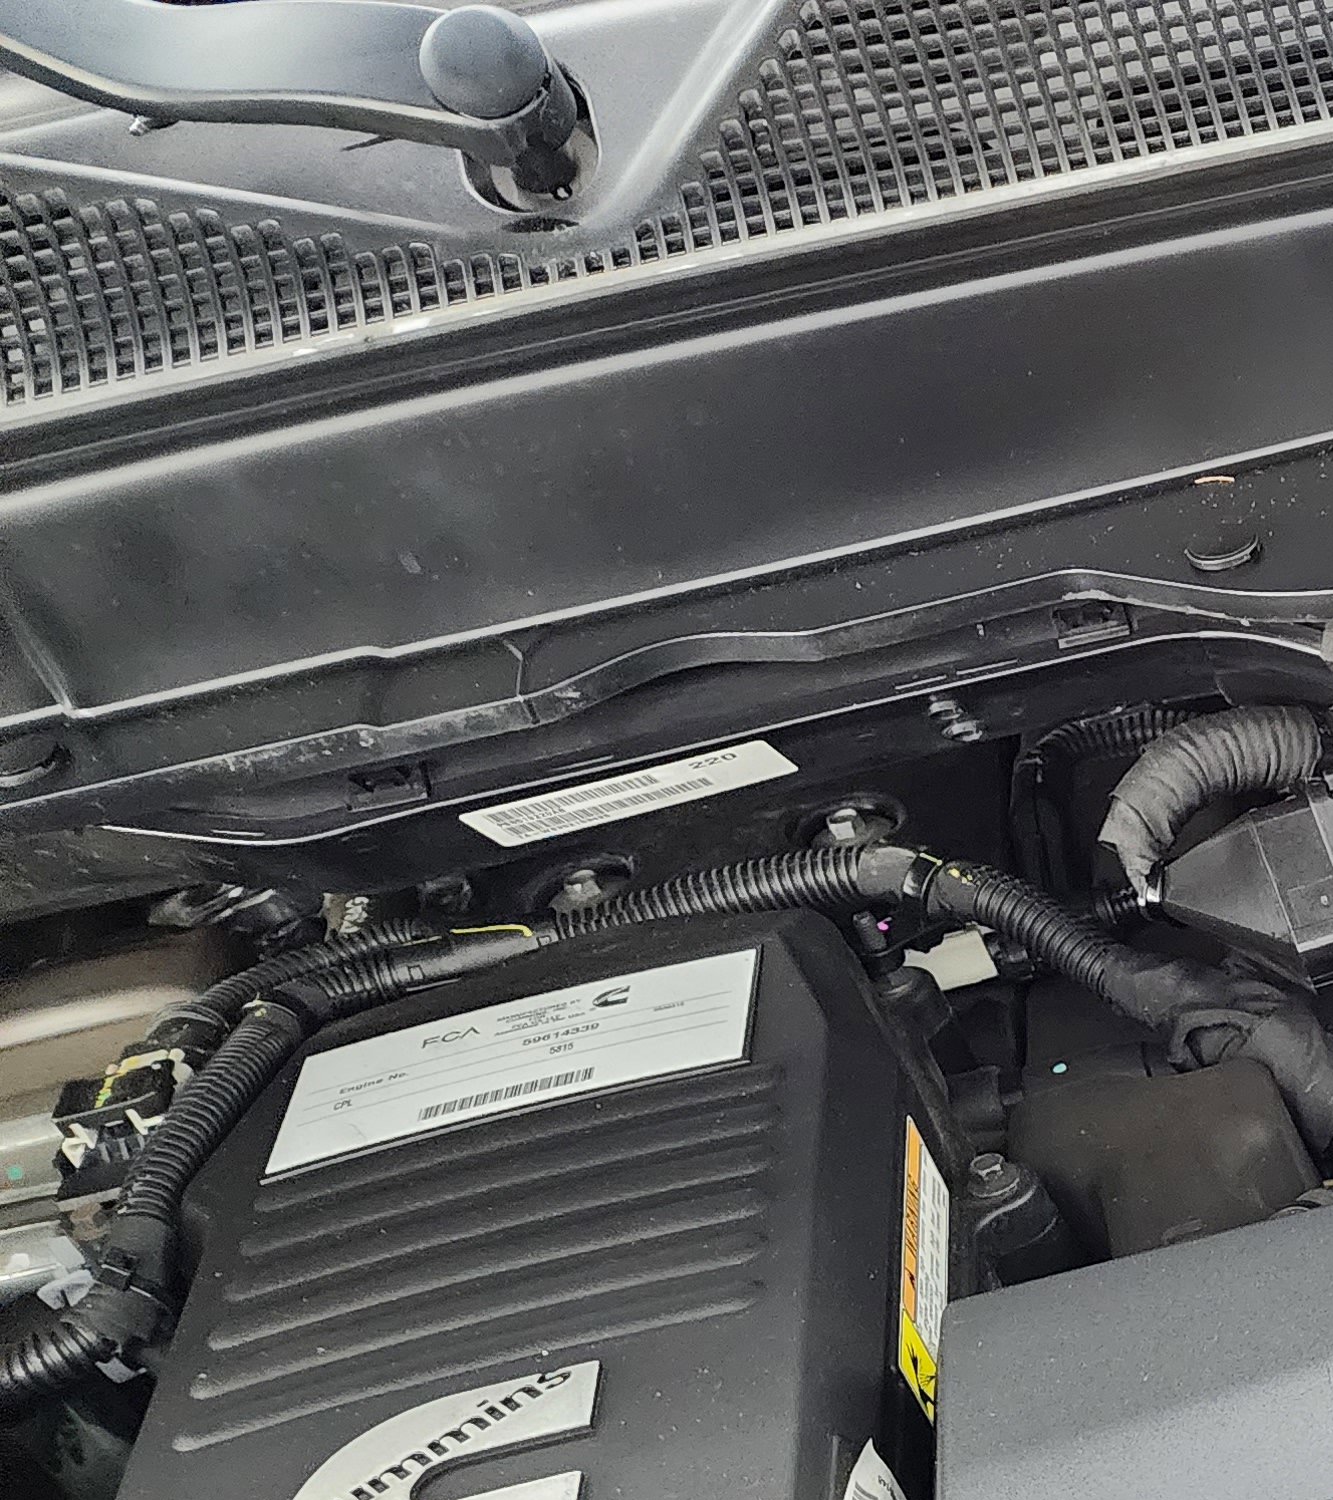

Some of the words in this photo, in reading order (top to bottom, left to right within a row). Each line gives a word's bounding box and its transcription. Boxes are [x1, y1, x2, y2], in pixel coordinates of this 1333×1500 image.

[688, 752, 738, 770] 220
[422, 1026, 480, 1048] FCA
[339, 1077, 384, 1095] Engine
[522, 1022, 600, 1046] 59614339
[333, 1098, 353, 1112] CPL
